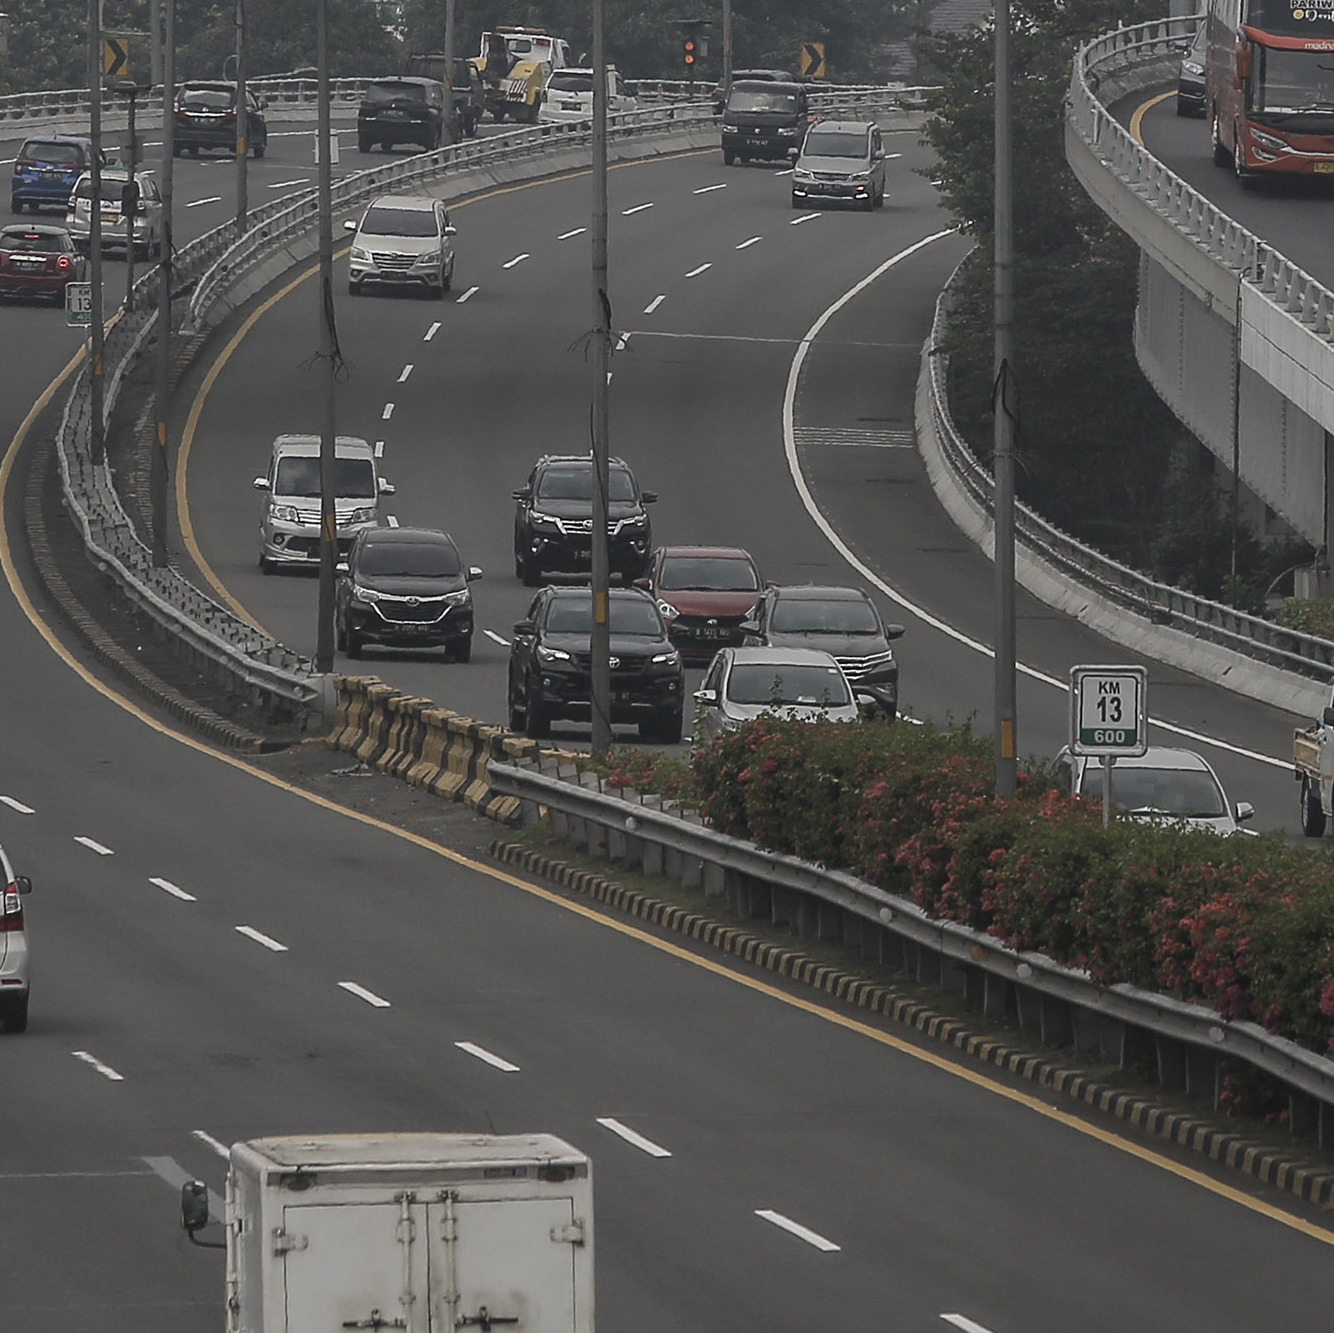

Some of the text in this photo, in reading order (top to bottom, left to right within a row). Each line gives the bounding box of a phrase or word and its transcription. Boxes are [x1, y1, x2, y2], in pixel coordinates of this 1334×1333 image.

[78, 297, 92, 311] 13
[1098, 681, 1120, 694] KM
[1097, 696, 1122, 723] 13
[1093, 729, 1126, 744] 600
